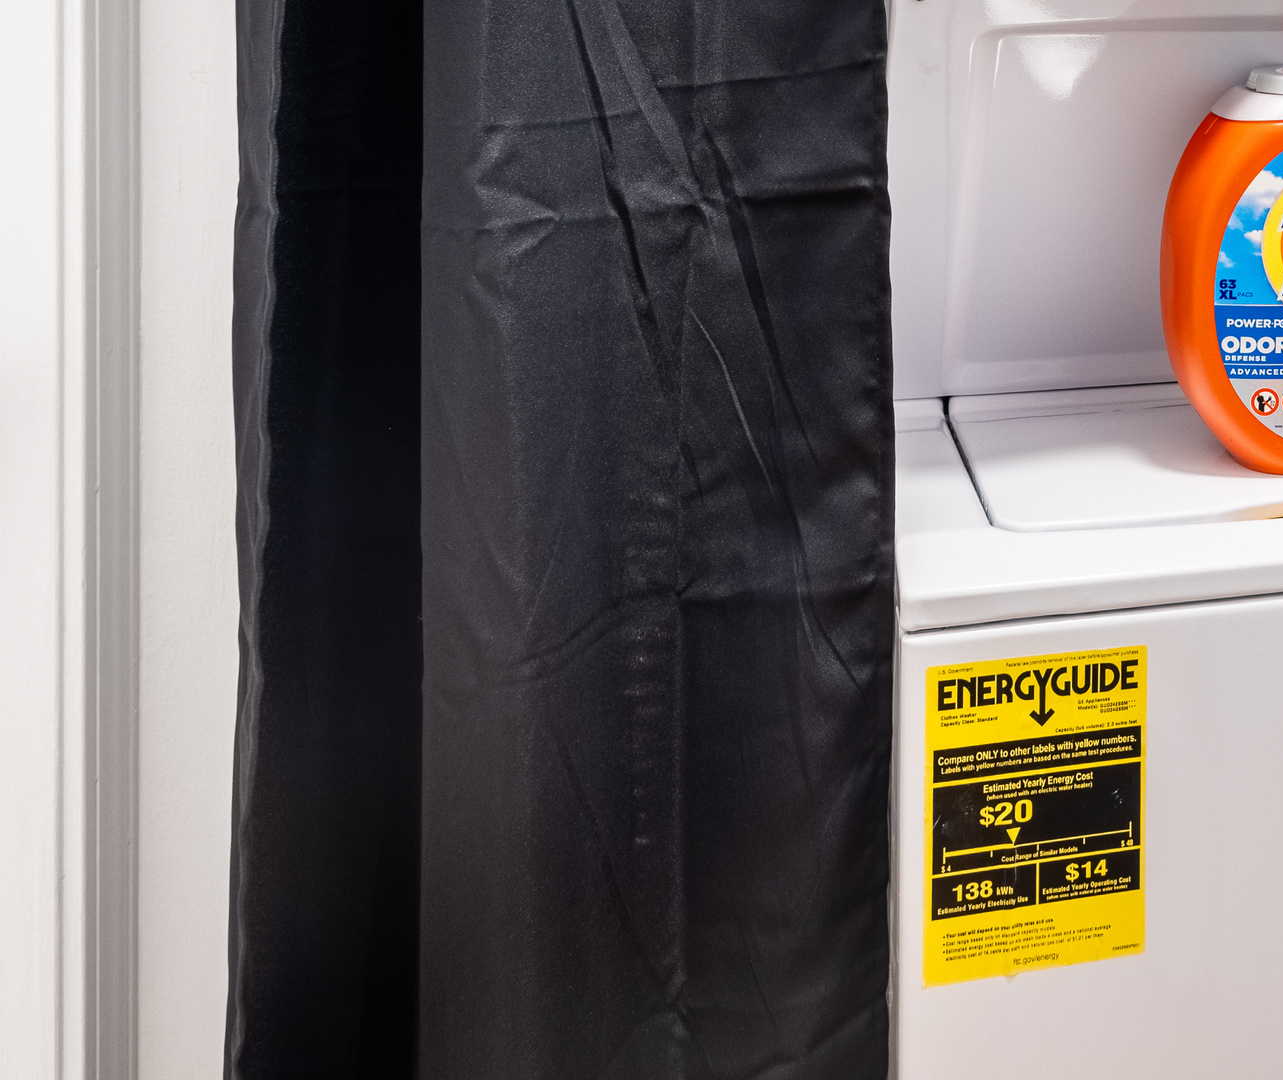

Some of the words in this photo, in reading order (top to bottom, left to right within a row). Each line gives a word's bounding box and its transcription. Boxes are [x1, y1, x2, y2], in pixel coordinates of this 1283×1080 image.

[1218, 289, 1237, 300] XL
[1219, 279, 1237, 290] 63
[938, 659, 1138, 711] ENERGYGUIDE
[938, 754, 974, 767] Compare
[976, 750, 999, 761] ONLY
[1000, 748, 1008, 758] to
[1010, 746, 1030, 757] other
[1032, 743, 1055, 754] labels
[1057, 741, 1073, 751] with
[1074, 737, 1100, 750] yellow
[1101, 734, 1137, 745] numbers.
[941, 765, 961, 775] Labels
[962, 764, 975, 772] with
[976, 761, 995, 771] yellow
[996, 759, 1020, 767] numbers
[1034, 754, 1051, 763] based
[1100, 745, 1133, 755] procedures.
[983, 781, 1021, 794] Estimated
[1022, 778, 1046, 789] Yearly
[1048, 774, 1074, 786] Energy
[1076, 771, 1093, 781] Cost
[979, 799, 1033, 827] $20
[1001, 855, 1014, 863] Cost
[1015, 852, 1032, 860] Range
[1040, 849, 1058, 857] Similar
[1059, 846, 1078, 855] Models
[1065, 859, 1108, 882] $14
[952, 881, 994, 902] 138
[996, 886, 1014, 896] kWh
[1043, 885, 1070, 895] Estimated
[1071, 882, 1089, 891] Yearly
[1090, 878, 1117, 889] Operating
[1119, 876, 1131, 884] Cost
[937, 905, 966, 916] Estimated
[967, 902, 986, 912] Yearly
[987, 897, 1016, 908] Electricity
[1017, 895, 1028, 903] Use
